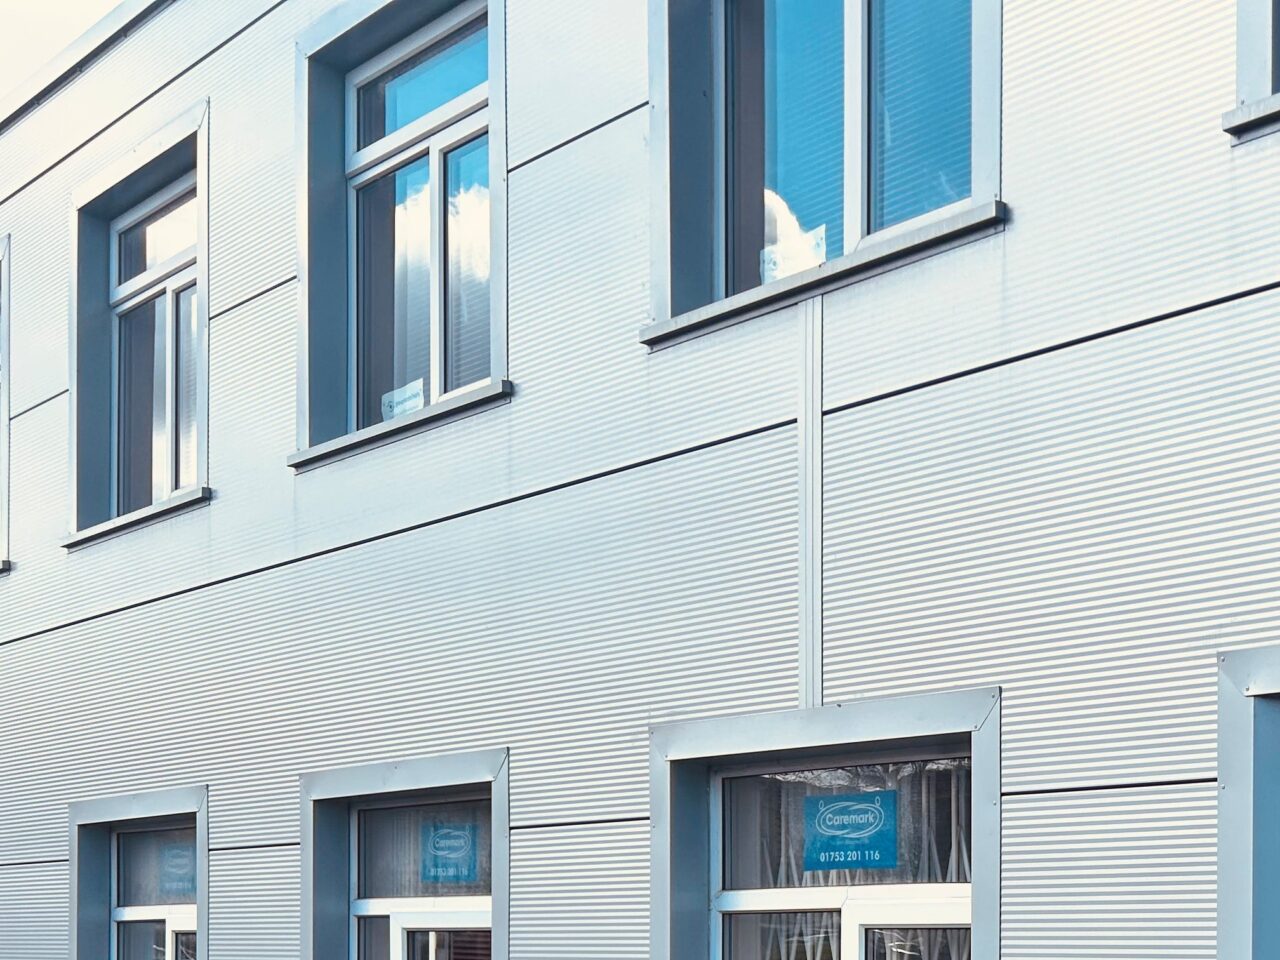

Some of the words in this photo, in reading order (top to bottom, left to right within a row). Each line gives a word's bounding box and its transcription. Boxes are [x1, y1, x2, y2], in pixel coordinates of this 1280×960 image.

[825, 811, 875, 826] Caremark
[820, 851, 845, 862] 01753
[846, 850, 861, 861] 201
[864, 850, 880, 860] 116
